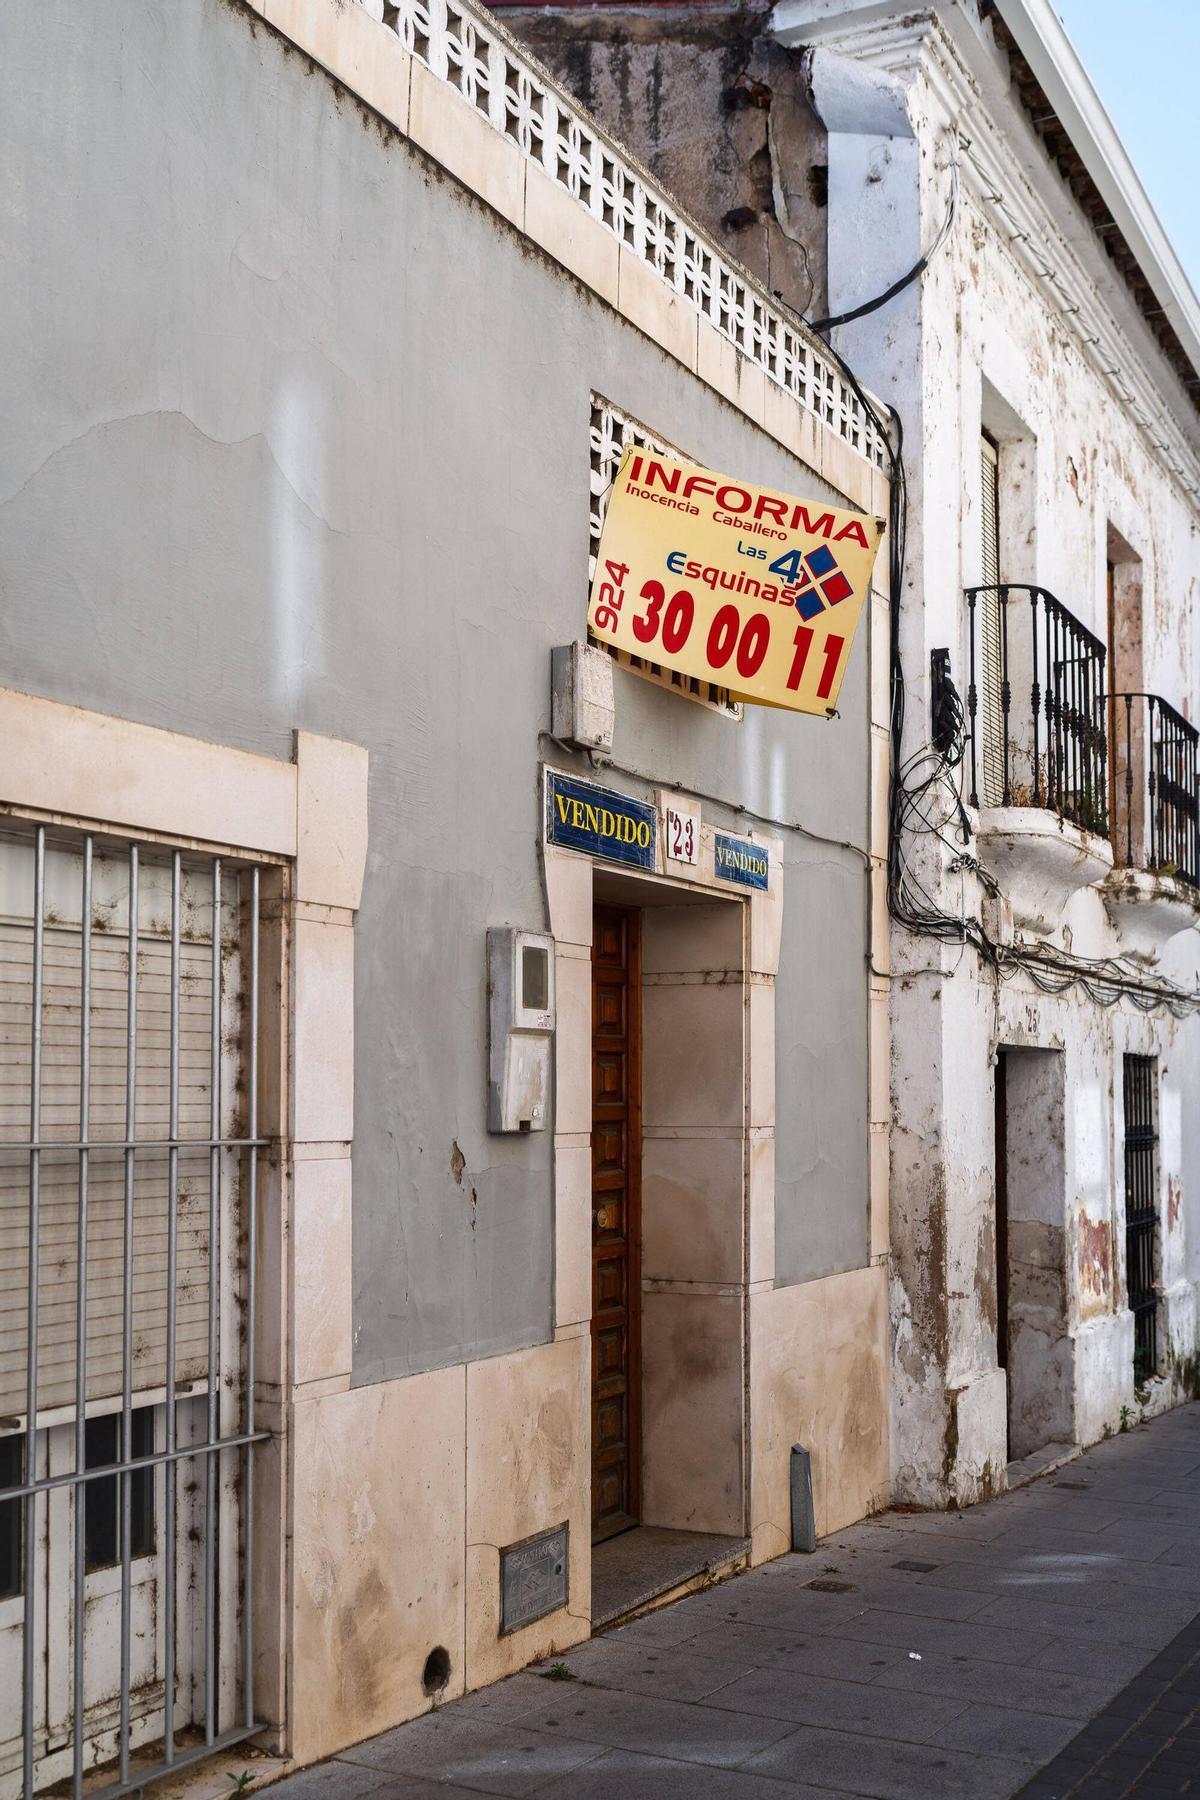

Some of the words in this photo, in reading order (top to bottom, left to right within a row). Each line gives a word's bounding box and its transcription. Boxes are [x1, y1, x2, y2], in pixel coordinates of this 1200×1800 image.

[625, 482, 700, 516] Inocencia
[712, 510, 788, 542] Caballero
[629, 456, 870, 549] INFORMA
[666, 551, 798, 608] Esquinas
[737, 540, 768, 561] Las
[768, 549, 802, 584] 4
[594, 559, 630, 634] 924
[632, 579, 695, 654] 30
[706, 604, 771, 678] 00
[785, 625, 845, 699] 11
[555, 793, 650, 849] VENDIDO
[673, 814, 694, 863] 23
[716, 846, 767, 877] VENDIDO
